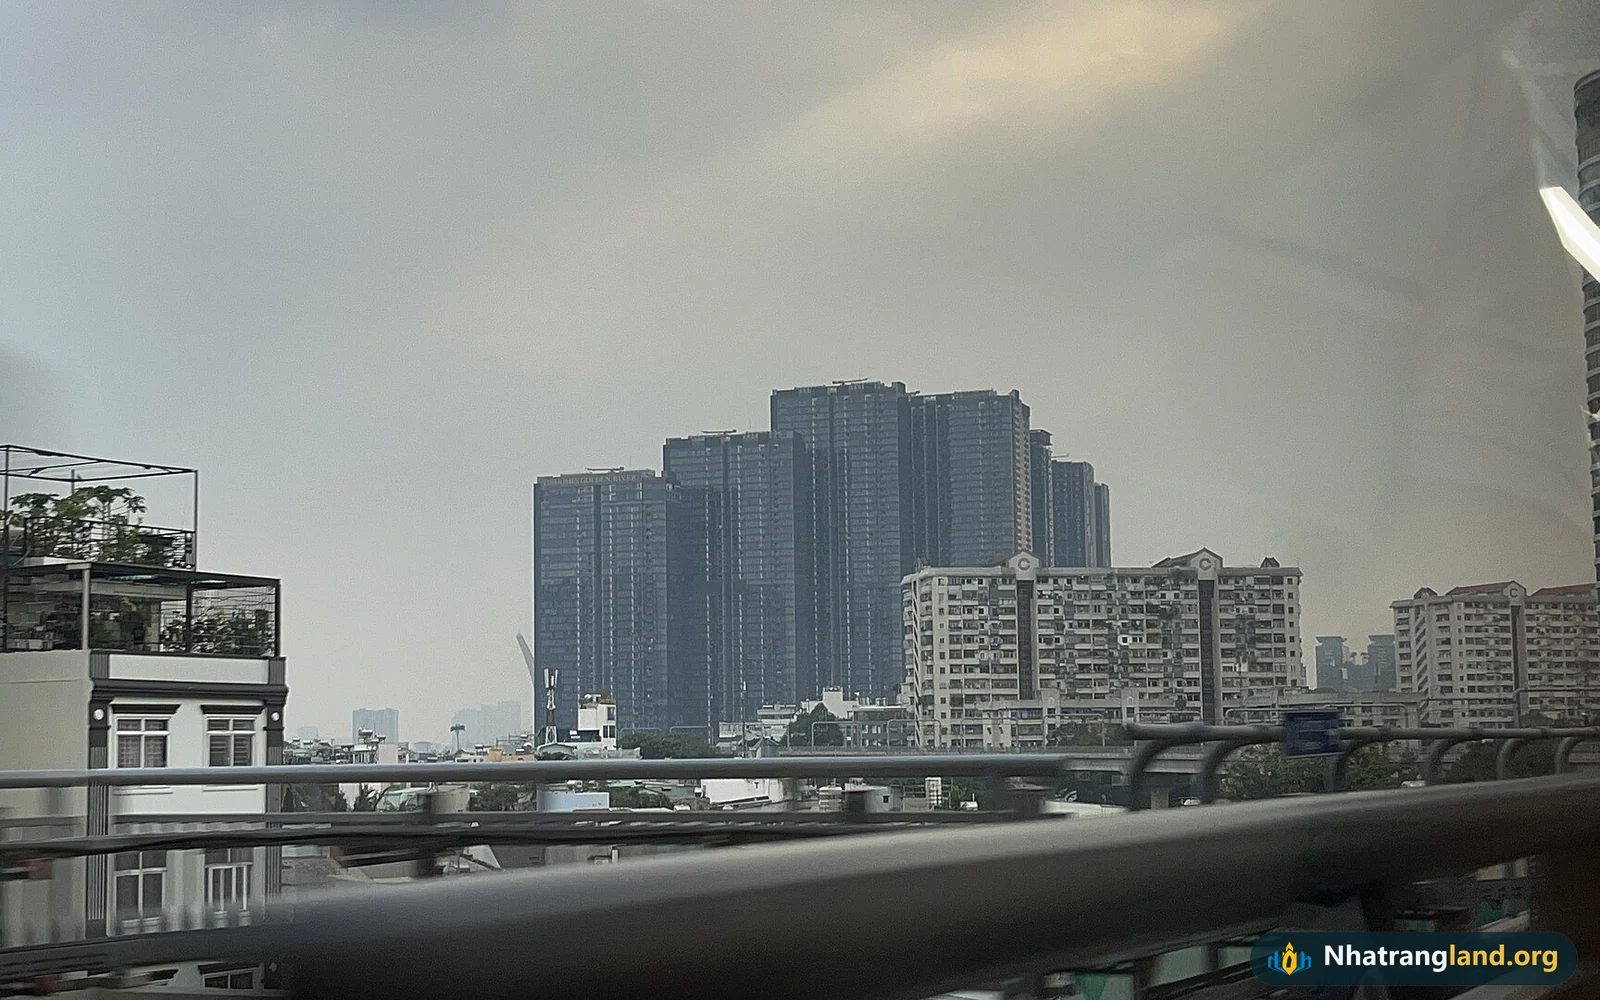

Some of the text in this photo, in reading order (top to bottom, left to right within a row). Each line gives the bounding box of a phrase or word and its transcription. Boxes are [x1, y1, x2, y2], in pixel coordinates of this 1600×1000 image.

[1018, 558, 1031, 571] C
[1199, 558, 1212, 571] C
[1510, 588, 1519, 598] C
